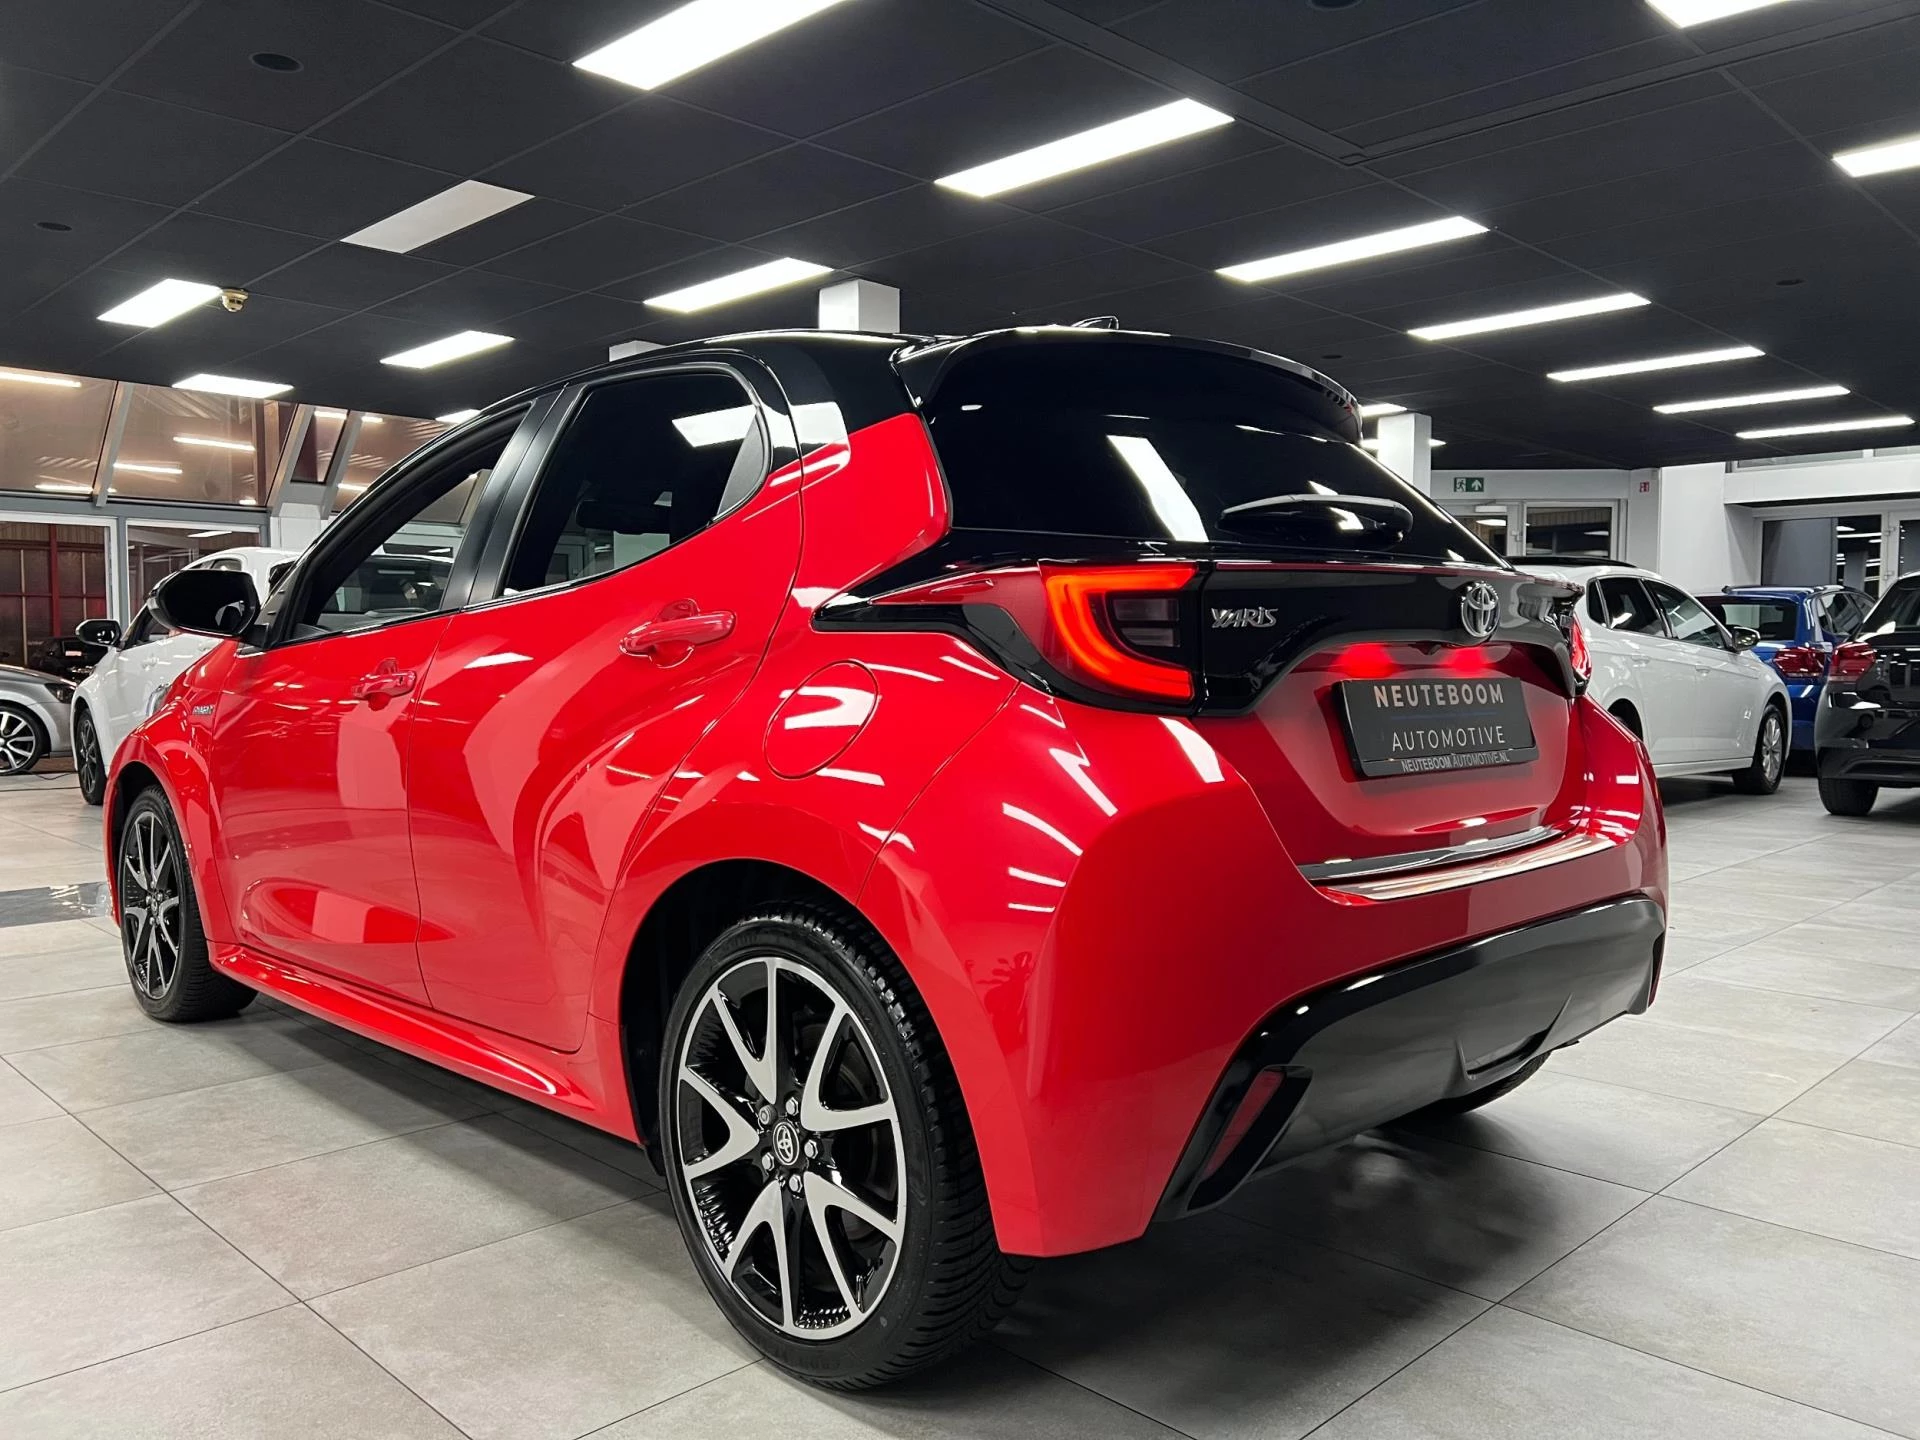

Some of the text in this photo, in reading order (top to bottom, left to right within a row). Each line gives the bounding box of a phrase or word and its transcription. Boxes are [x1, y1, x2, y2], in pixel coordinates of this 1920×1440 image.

[1211, 607, 1278, 628] YARIS
[1373, 683, 1504, 708] NEUTEBOOM
[1392, 726, 1505, 752] AUTOMOTIVE
